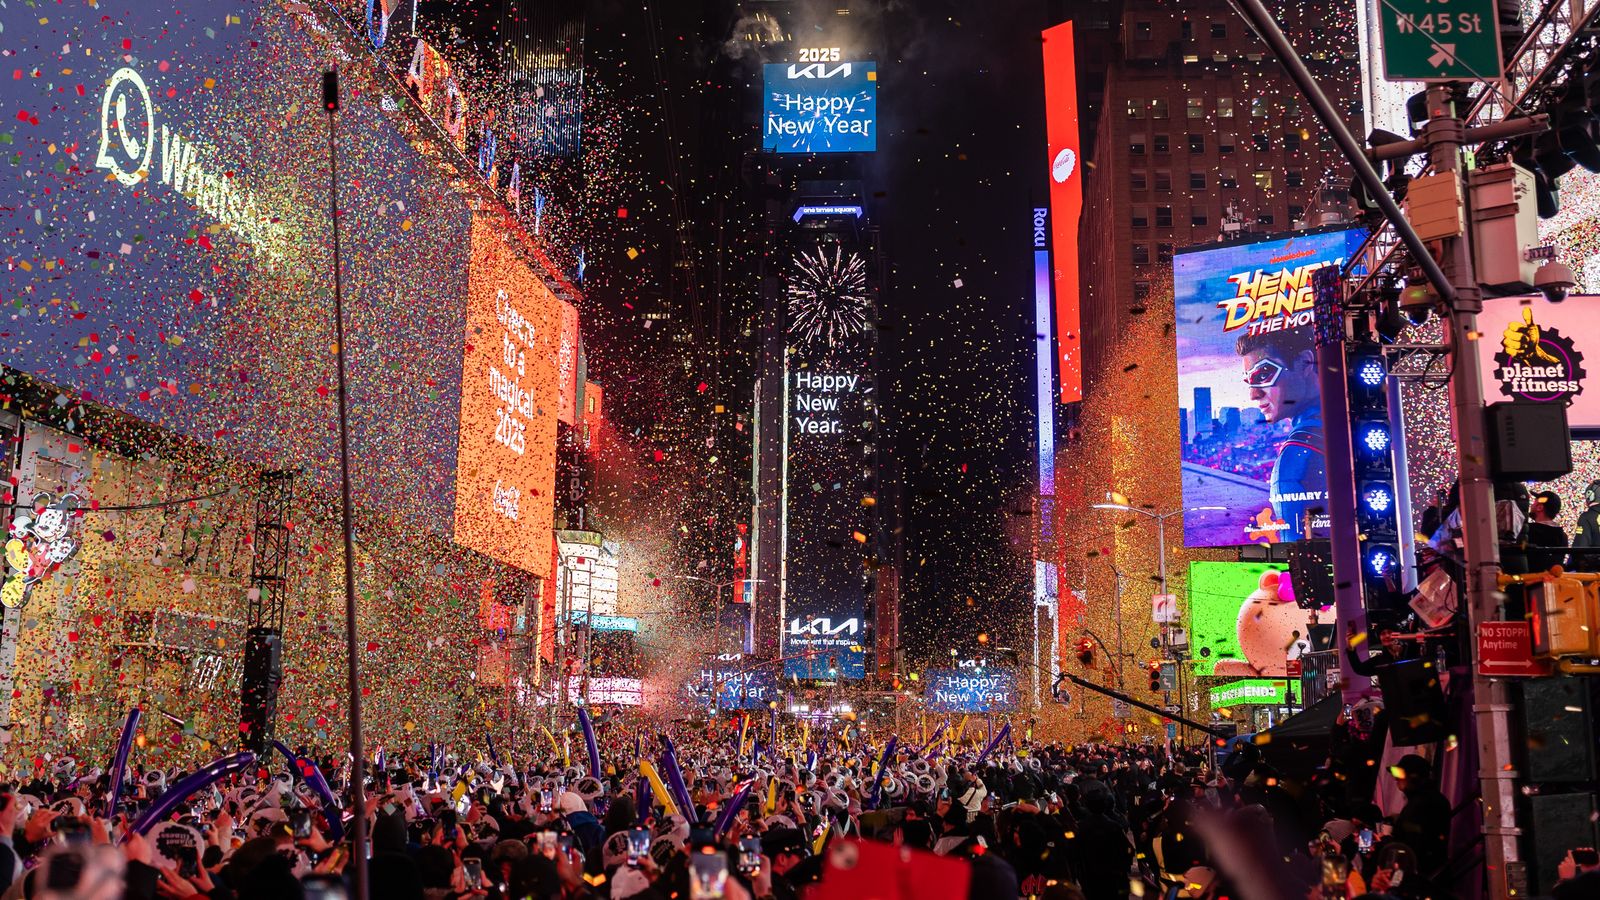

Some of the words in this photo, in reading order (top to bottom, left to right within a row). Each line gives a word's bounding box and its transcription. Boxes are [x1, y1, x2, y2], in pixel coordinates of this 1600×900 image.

[1395, 13, 1414, 34] W
[1419, 13, 1452, 34] 45
[1458, 13, 1482, 34] St
[799, 48, 840, 62] 2025
[787, 63, 852, 79] KIA
[785, 93, 856, 114] Happy
[768, 117, 815, 134] New
[823, 117, 872, 135] Year
[1033, 207, 1048, 247] Roku
[495, 289, 536, 349] Cheers
[1250, 318, 1282, 336] THE
[503, 331, 516, 369] to
[518, 351, 525, 377] a
[1502, 363, 1565, 382] planet
[796, 372, 858, 392] Happy
[1511, 377, 1579, 392] fitness
[490, 365, 535, 421] magical
[796, 395, 838, 411] New
[495, 407, 526, 455] 2025
[796, 417, 842, 434] Year.
[1269, 491, 1321, 502] JANUARY
[1244, 523, 1290, 533] nilodeon
[790, 617, 858, 635] KIA
[1481, 627, 1494, 637] NO
[823, 638, 834, 646] that
[1483, 639, 1518, 651] Anytime
[948, 676, 999, 689] Happy
[936, 690, 969, 703] New
[976, 690, 1010, 704] Year
